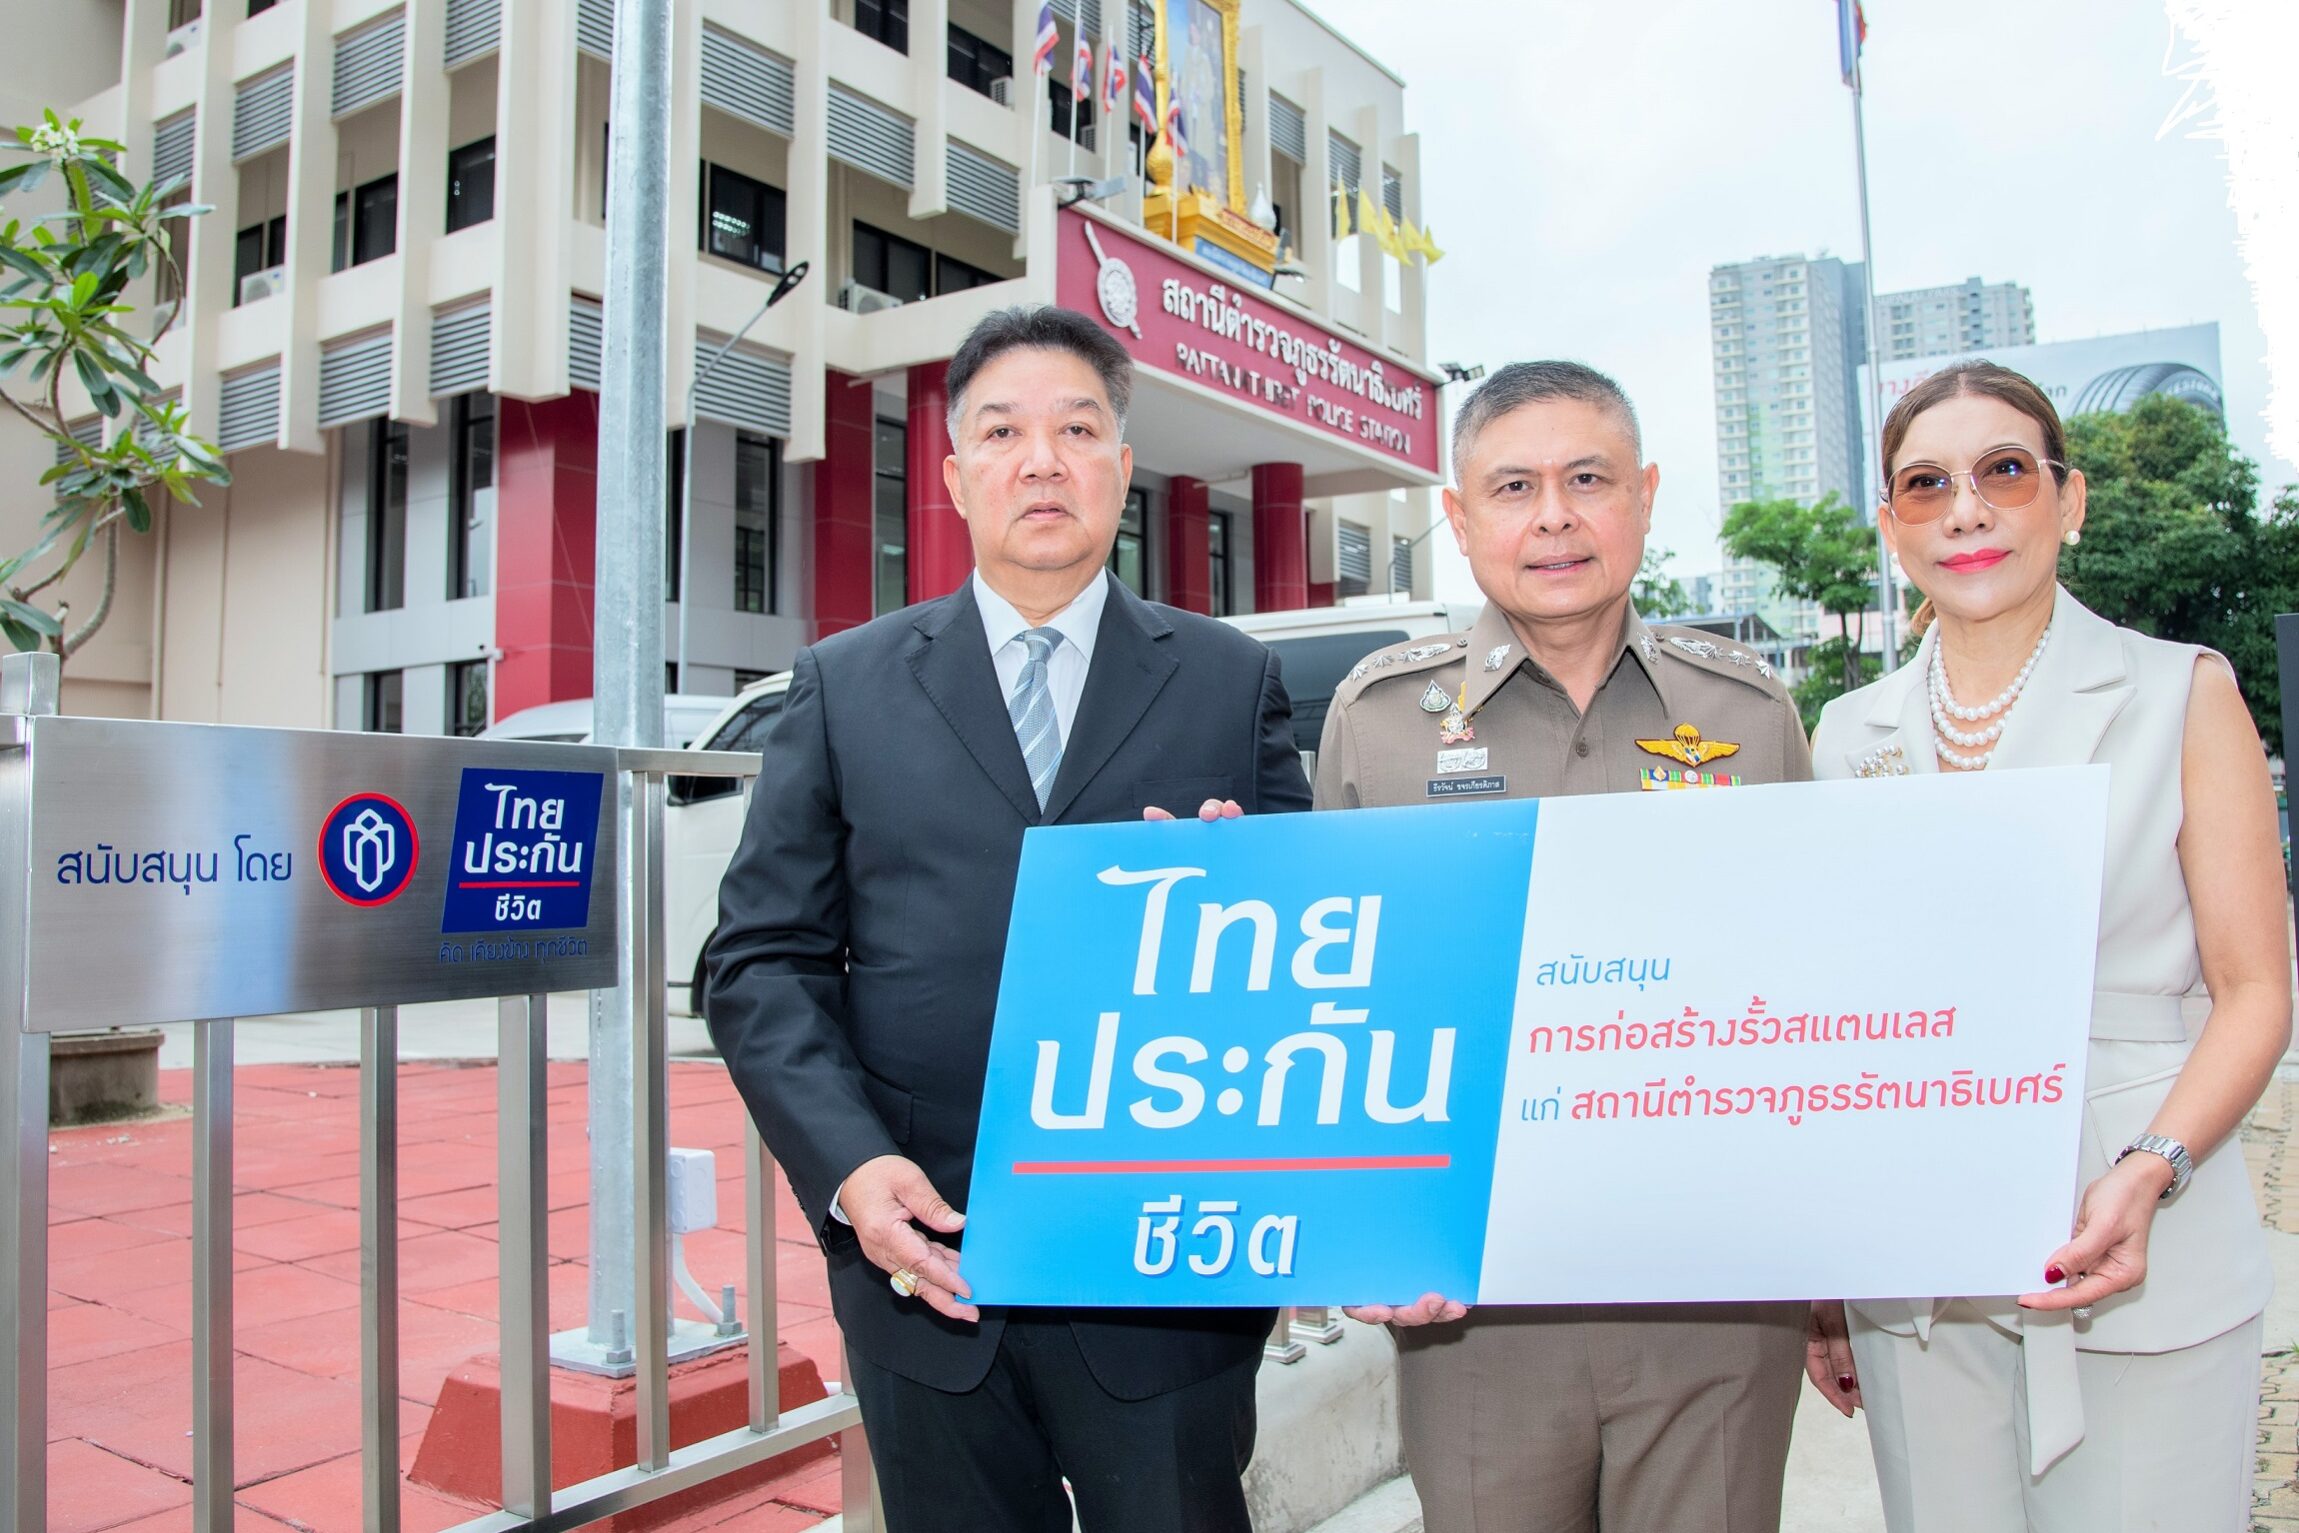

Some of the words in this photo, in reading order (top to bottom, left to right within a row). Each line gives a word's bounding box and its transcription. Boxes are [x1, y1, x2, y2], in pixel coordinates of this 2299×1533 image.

[484, 782, 565, 831] ไทย
[56, 844, 218, 895] สนับสนุน
[234, 834, 292, 882] โดย
[464, 832, 582, 875] ประกัน
[494, 894, 542, 921] ชีวิต
[1096, 864, 1382, 995] ไทย
[439, 942, 463, 964] คิด
[470, 936, 529, 962] เคียงข้าง
[535, 936, 588, 965] ทุกชีวิต
[1536, 954, 1671, 991] สนับสนุน
[1529, 995, 1957, 1054] การก่อสร้างรั้วสแตนเลส
[1030, 1001, 1457, 1130] ประกัน
[1521, 1087, 1561, 1121] แก่
[1571, 1063, 2066, 1126] สถานีตำรวจภูธรรัตนาธิเบศร์
[1133, 1194, 1299, 1277] ชีวิต
